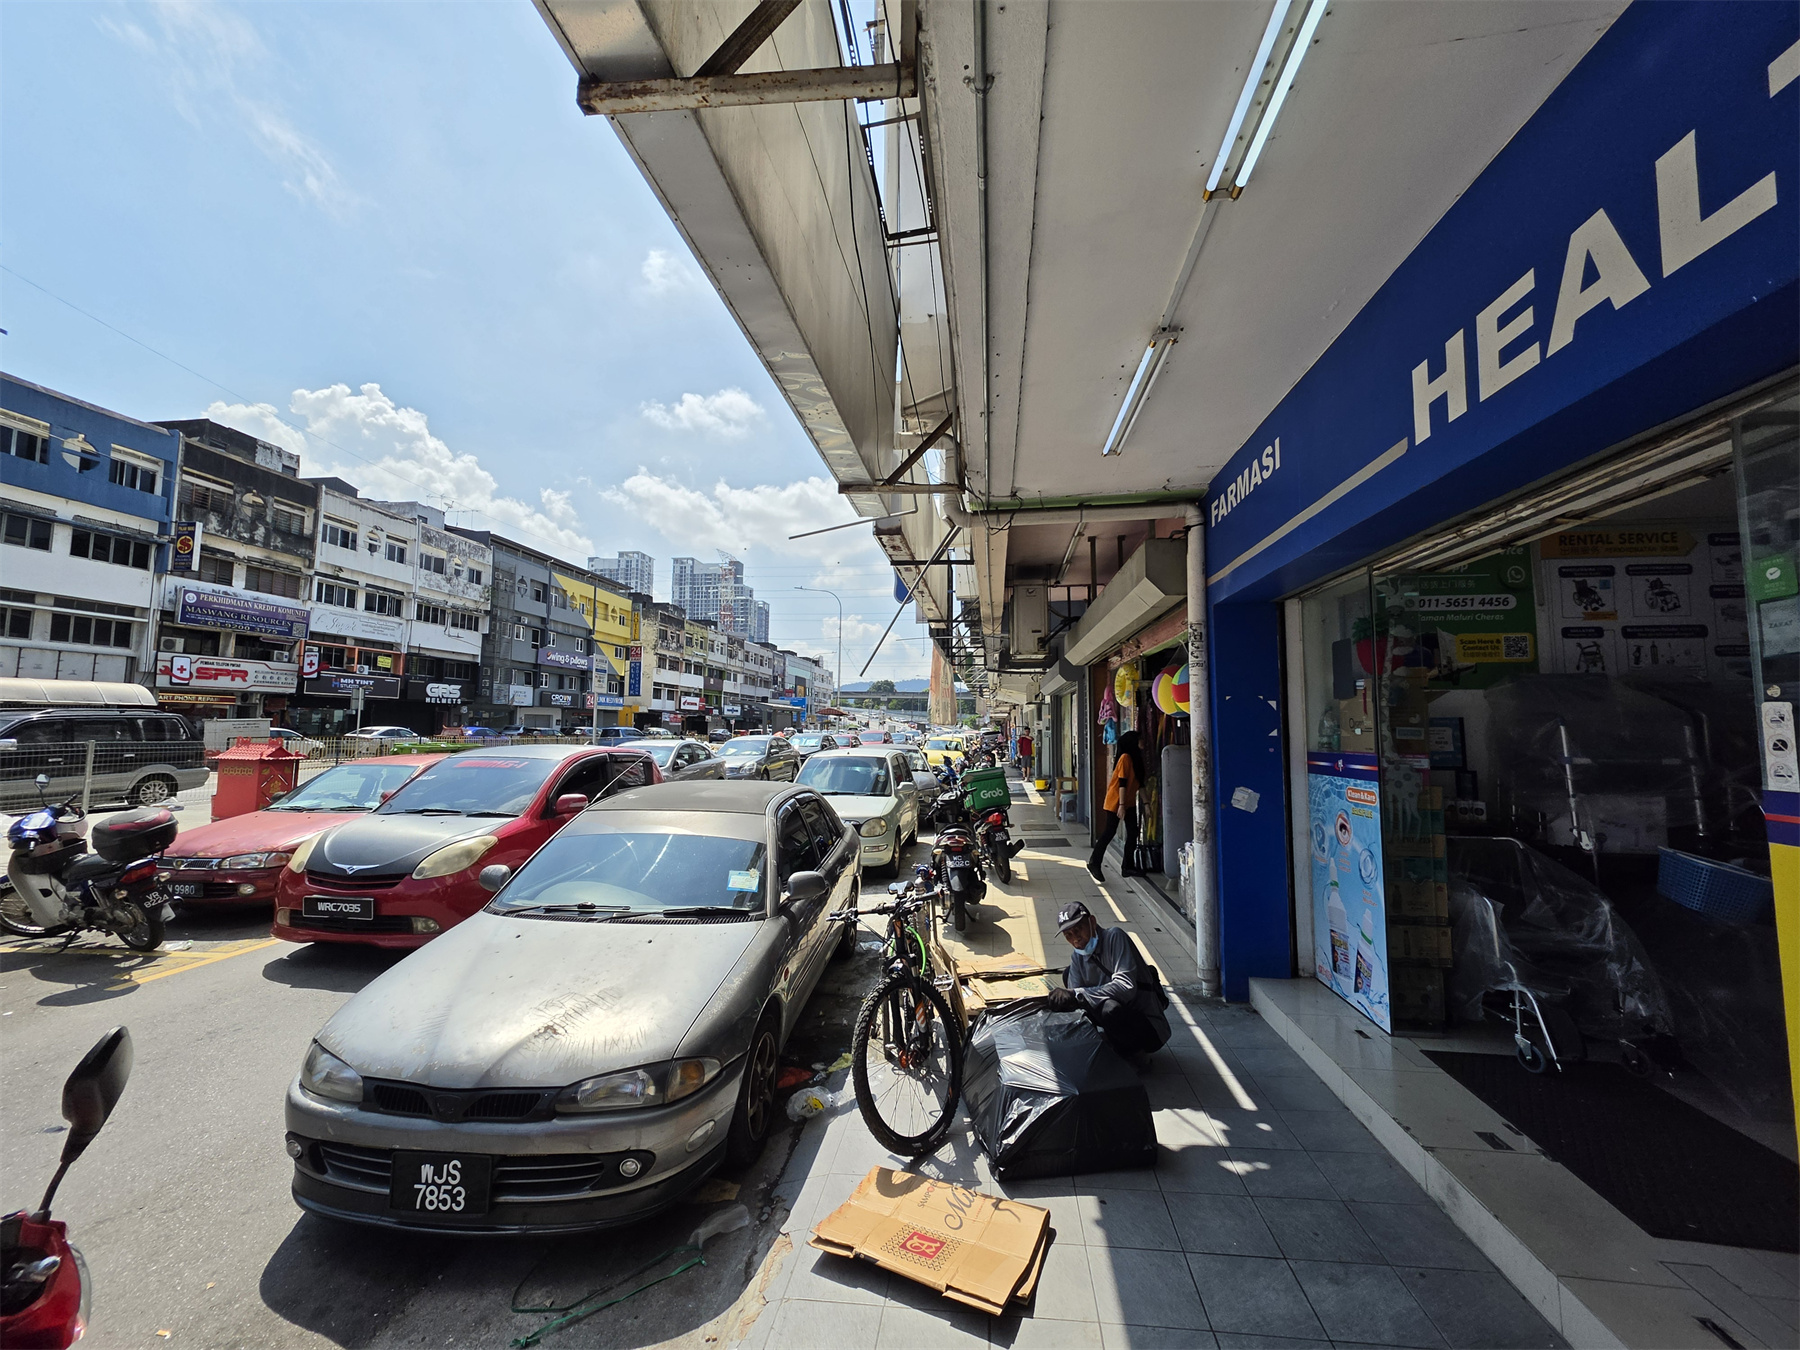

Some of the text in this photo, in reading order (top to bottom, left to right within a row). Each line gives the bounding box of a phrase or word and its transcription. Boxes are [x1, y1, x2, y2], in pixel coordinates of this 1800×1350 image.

[1210, 437, 1281, 527] FARMASI
[1559, 532, 1678, 546] RENTAL SERVICE
[200, 593, 307, 617] PERKHIDMATAN KREDIT KOMUNITI
[1419, 597, 1510, 608] 011-5651 4456
[185, 605, 292, 627] MASWANG RESOURCES
[1446, 613, 1473, 621] Maluri
[1475, 613, 1504, 621] Cheras
[631, 647, 641, 655] 24
[195, 667, 248, 682] SPR
[551, 694, 572, 702] CROWN
[586, 695, 594, 705] 24
[980, 788, 1004, 799] Grab
[174, 885, 195, 894] 9980
[317, 901, 361, 914] WRC7035
[421, 1160, 462, 1185] WJS
[413, 1184, 466, 1211] 7853
